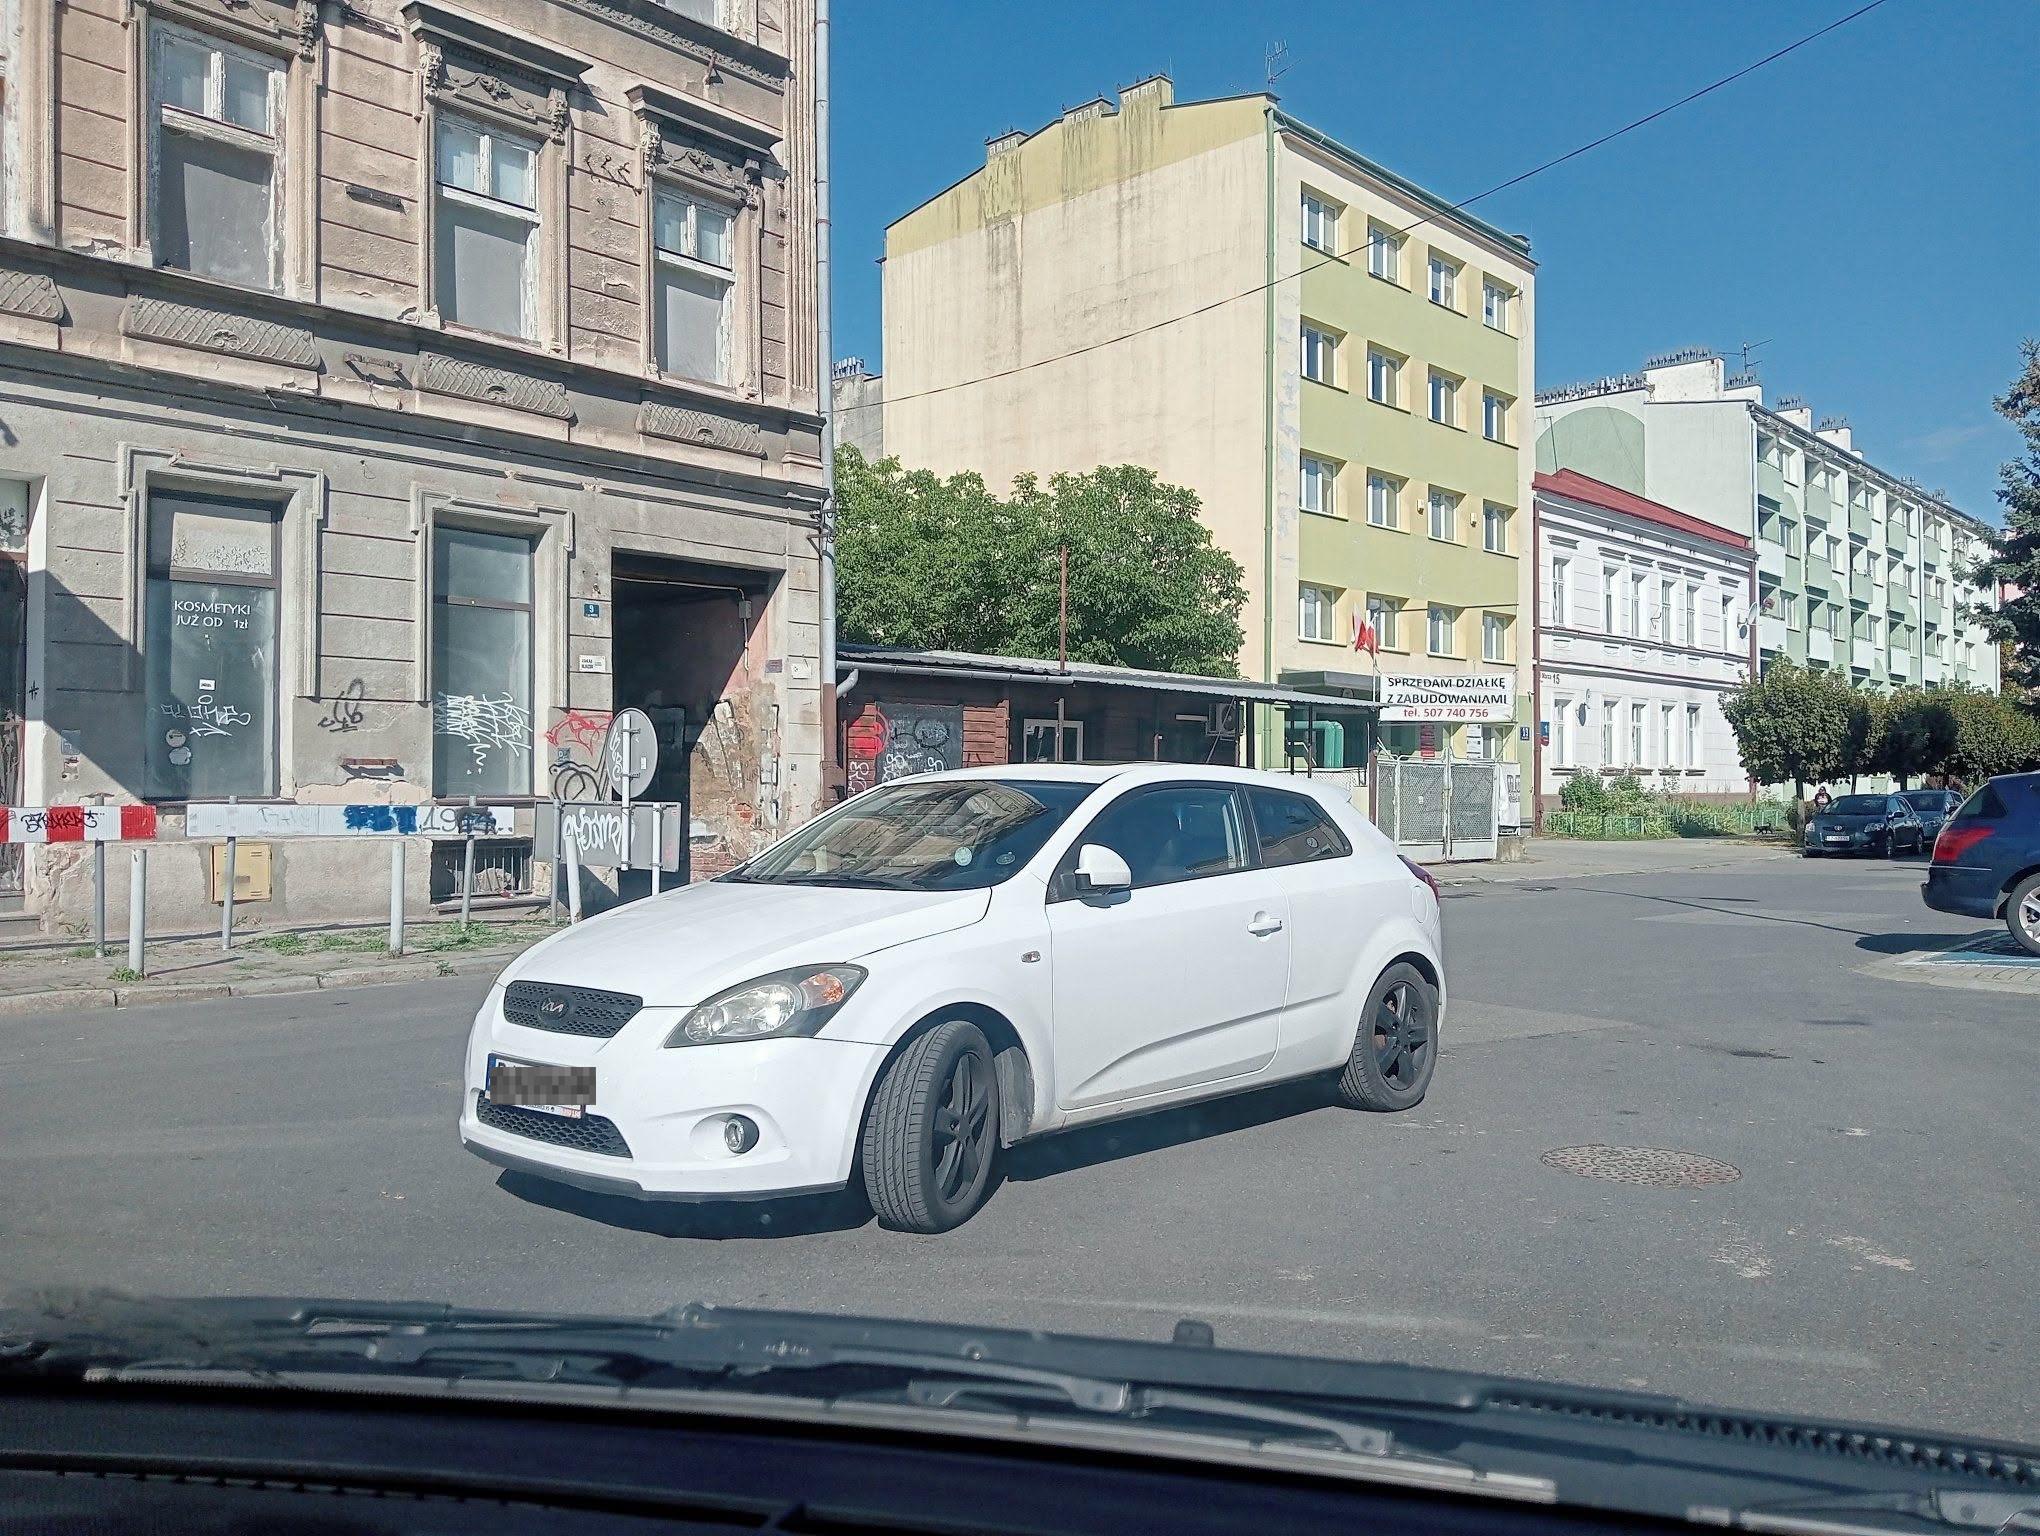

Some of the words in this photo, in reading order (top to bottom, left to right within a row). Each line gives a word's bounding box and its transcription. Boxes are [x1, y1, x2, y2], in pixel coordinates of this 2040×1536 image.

[174, 600, 251, 615] KOSMETYKI
[176, 613, 199, 626] JUŻ
[203, 616, 223, 627] OD
[1388, 677, 1452, 688] SPRZEDAM
[1456, 677, 1506, 690] DZIAŁKĘ
[1387, 694, 1394, 704] Z
[1397, 694, 1507, 705] ZABUDOWANIAMI
[1403, 708, 1420, 717] tel.
[1424, 708, 1443, 717] 507
[1446, 708, 1466, 717] 740
[1469, 708, 1489, 717] 756
